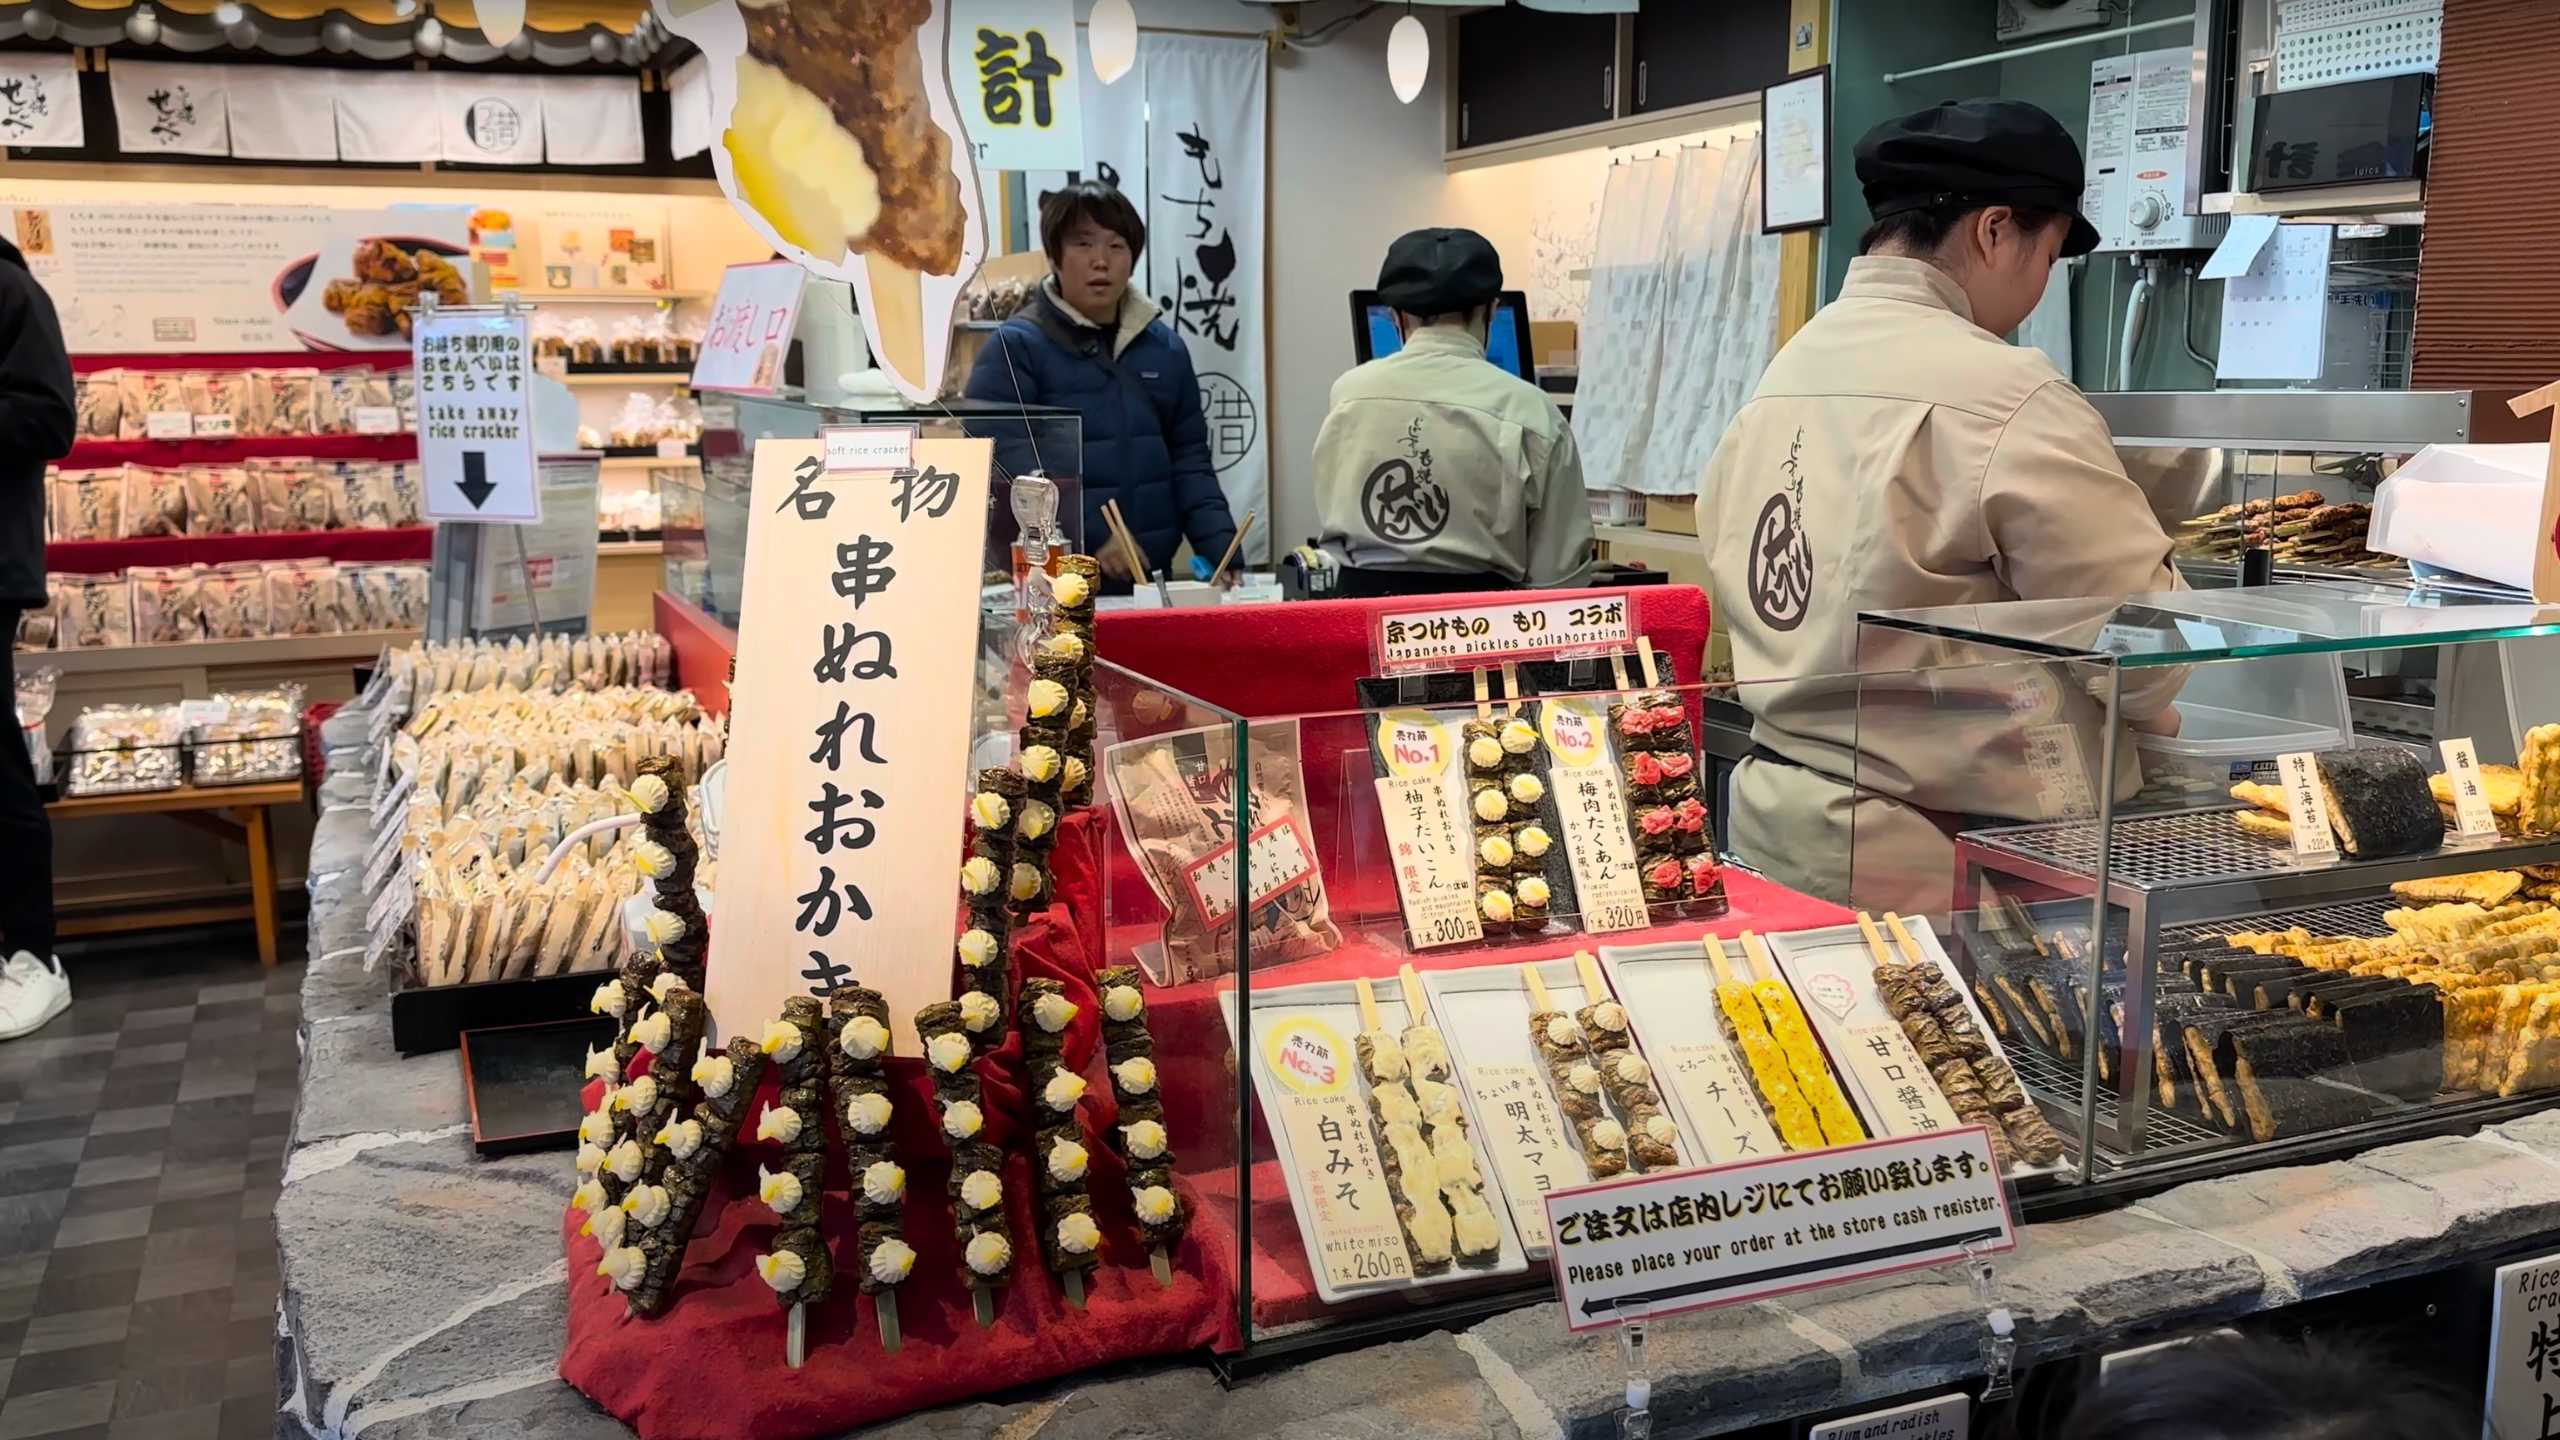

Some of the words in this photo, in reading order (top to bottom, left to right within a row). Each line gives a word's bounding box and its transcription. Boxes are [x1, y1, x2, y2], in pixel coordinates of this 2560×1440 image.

[975, 28, 1063, 128] 計
[422, 355, 521, 372] おせんべいは
[422, 374, 521, 391] こちらです
[428, 404, 464, 420] take
[478, 406, 518, 421] away
[429, 422, 455, 438] rice
[463, 424, 519, 438] cracker
[1386, 616, 1490, 644] 京つけもの
[1513, 610, 1546, 632] もり
[1569, 602, 1624, 627] コラボ
[1387, 644, 1456, 659] Japanese
[1528, 629, 1626, 648] collaboration
[1394, 743, 1440, 764] No.1
[1554, 728, 1595, 749] No.2
[2293, 756, 2316, 824] 特上海苔
[2456, 751, 2477, 796] 醤油
[1192, 825, 1290, 883] お持ちり用は
[1405, 789, 1444, 889] 柚子だいこん
[1578, 781, 1616, 880] 梅肉たくあん
[1279, 1047, 1337, 1086] No.3
[1866, 1034, 1940, 1132] 甘口醤油
[1294, 1095, 1319, 1106] Rice
[1322, 1094, 1346, 1105] cake
[1706, 1080, 1760, 1154] チーズ
[1317, 1114, 1361, 1211] 白みそ
[1346, 1103, 1376, 1181] 串ぬれおかき
[1505, 1100, 1552, 1191] 明太マヨ
[1556, 1150, 1989, 1246] ご注文は店内レジにてお願い致します。
[1568, 1259, 1624, 1285] Please
[1632, 1250, 1676, 1275] place
[1683, 1243, 1722, 1266] your
[1731, 1233, 1776, 1256] order
[1784, 1227, 1802, 1246] at
[1810, 1221, 1836, 1242] the
[1843, 1215, 1886, 1237] store
[1893, 1204, 1928, 1227] cash
[1934, 1194, 2001, 1220] register.
[1864, 1420, 1888, 1439] and
[1892, 1410, 1940, 1433] radish
